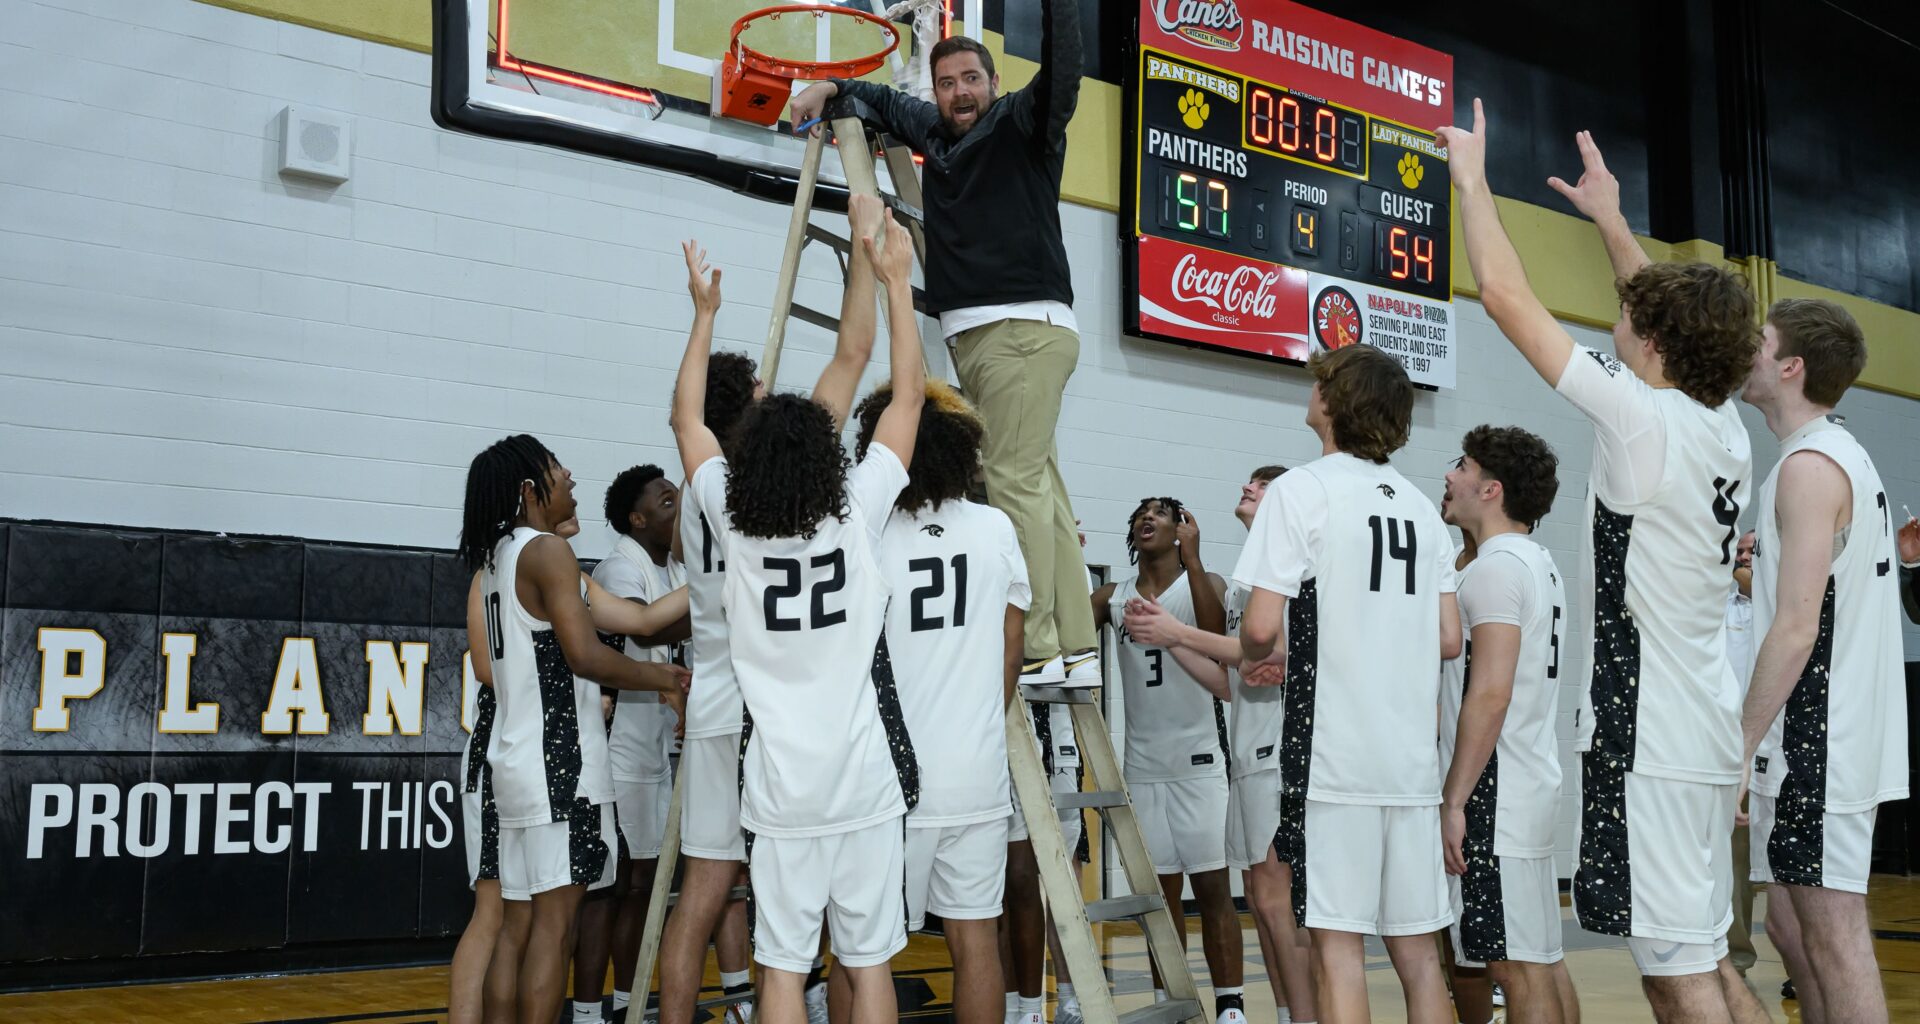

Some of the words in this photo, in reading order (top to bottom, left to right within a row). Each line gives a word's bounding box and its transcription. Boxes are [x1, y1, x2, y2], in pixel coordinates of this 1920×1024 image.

[1148, 58, 1239, 102] PANTHERS
[1252, 19, 1354, 79] RAISING
[1362, 56, 1442, 106] CANE'S
[1289, 88, 1326, 104] DAKTRONICS
[1148, 128, 1248, 178] PANTHERS
[1373, 125, 1399, 144] LADY
[1177, 174, 1228, 235] 57
[1284, 180, 1328, 206] PERIOD
[1380, 191, 1433, 226] GUEST
[1297, 212, 1314, 249] 4
[1390, 227, 1433, 282] 54
[1171, 253, 1279, 319] Coca-Cola
[1366, 293, 1423, 319] NAPOLI'S
[1423, 305, 1448, 325] PIZZA
[1212, 312, 1240, 326] classic
[1318, 293, 1358, 334] NAPOLI'S
[1369, 314, 1401, 334] SERVING
[1402, 320, 1427, 339] PLANO
[1428, 326, 1447, 342] EAST
[1369, 331, 1408, 352] STUDENTS
[1409, 339, 1425, 355] AND
[1426, 342, 1448, 359] STAFF
[1411, 357, 1431, 373] 1997
[1712, 476, 1740, 565] 4
[1368, 515, 1417, 595] 14
[763, 548, 847, 632] 22
[908, 554, 968, 632] 21
[485, 591, 505, 661] 10
[1547, 605, 1561, 679] 5
[32, 627, 471, 736] PLAN
[1144, 648, 1163, 687] 3
[26, 780, 332, 860] PROTECT
[352, 779, 454, 852] THIS
